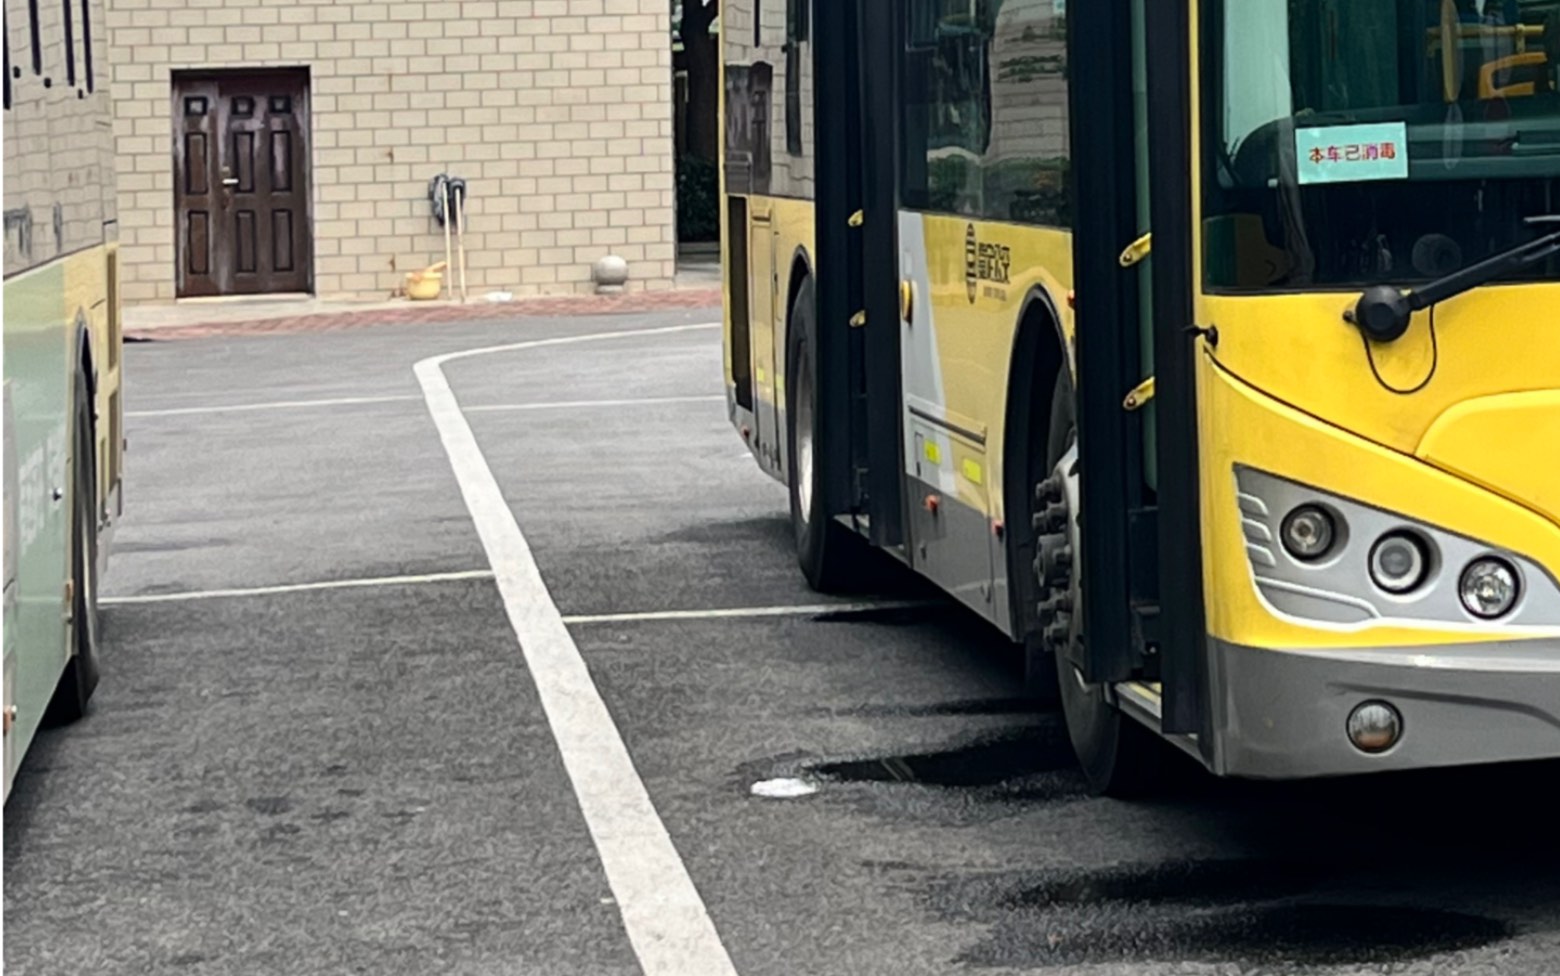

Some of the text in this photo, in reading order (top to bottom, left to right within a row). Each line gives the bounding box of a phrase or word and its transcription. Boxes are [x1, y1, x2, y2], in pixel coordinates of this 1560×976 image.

[1310, 143, 1395, 163] 本车已消毒
